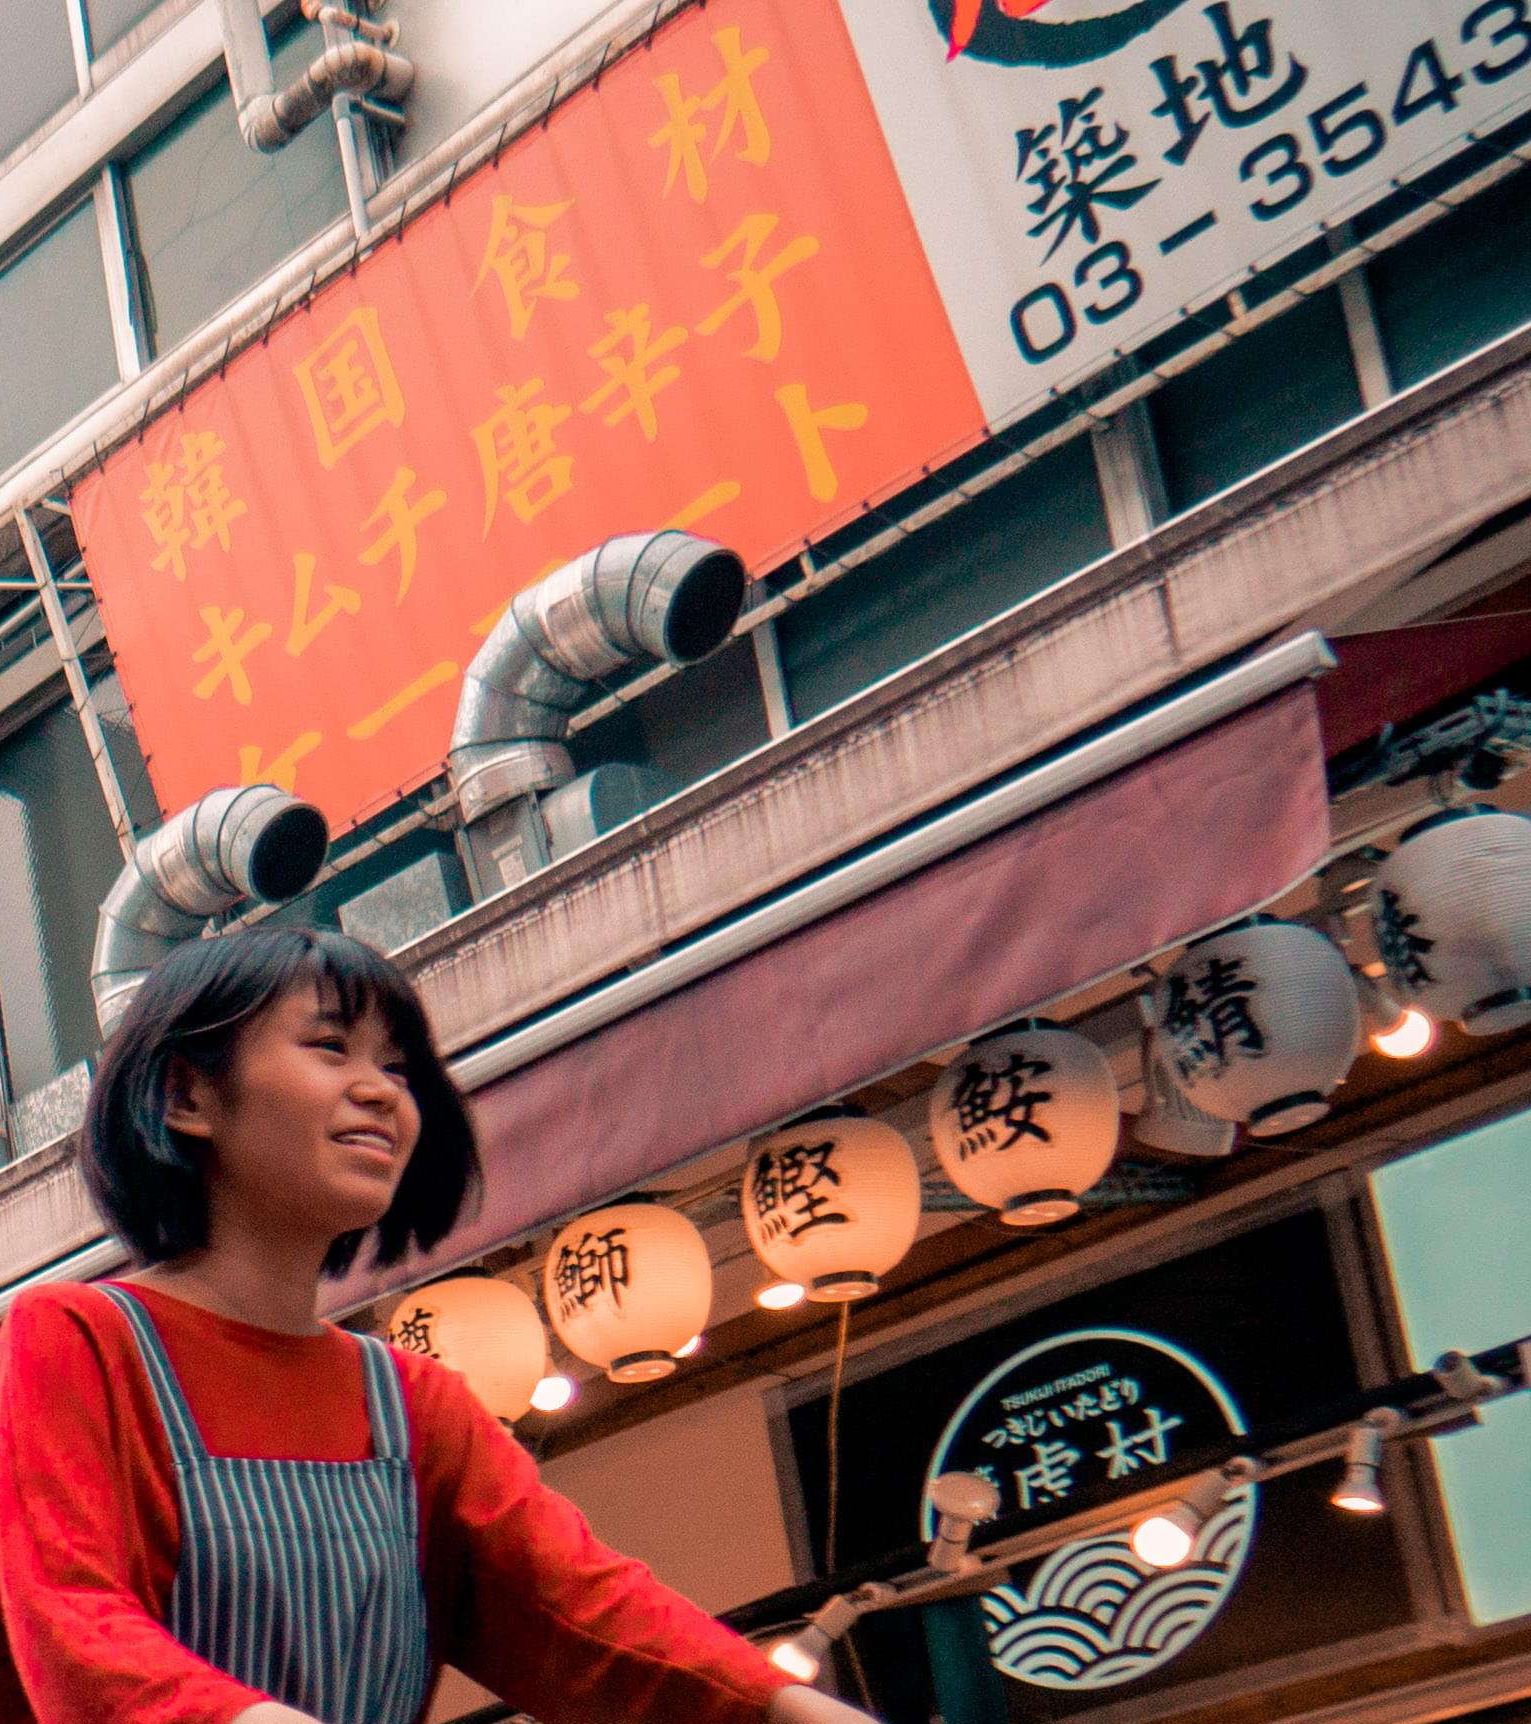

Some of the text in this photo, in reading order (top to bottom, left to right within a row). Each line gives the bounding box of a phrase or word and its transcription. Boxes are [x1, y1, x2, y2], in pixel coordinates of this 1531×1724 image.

[1015, 2, 1310, 266] 築地
[140, 26, 771, 581] 韓国食材
[981, 1377, 1141, 1449] つきじいたどり
